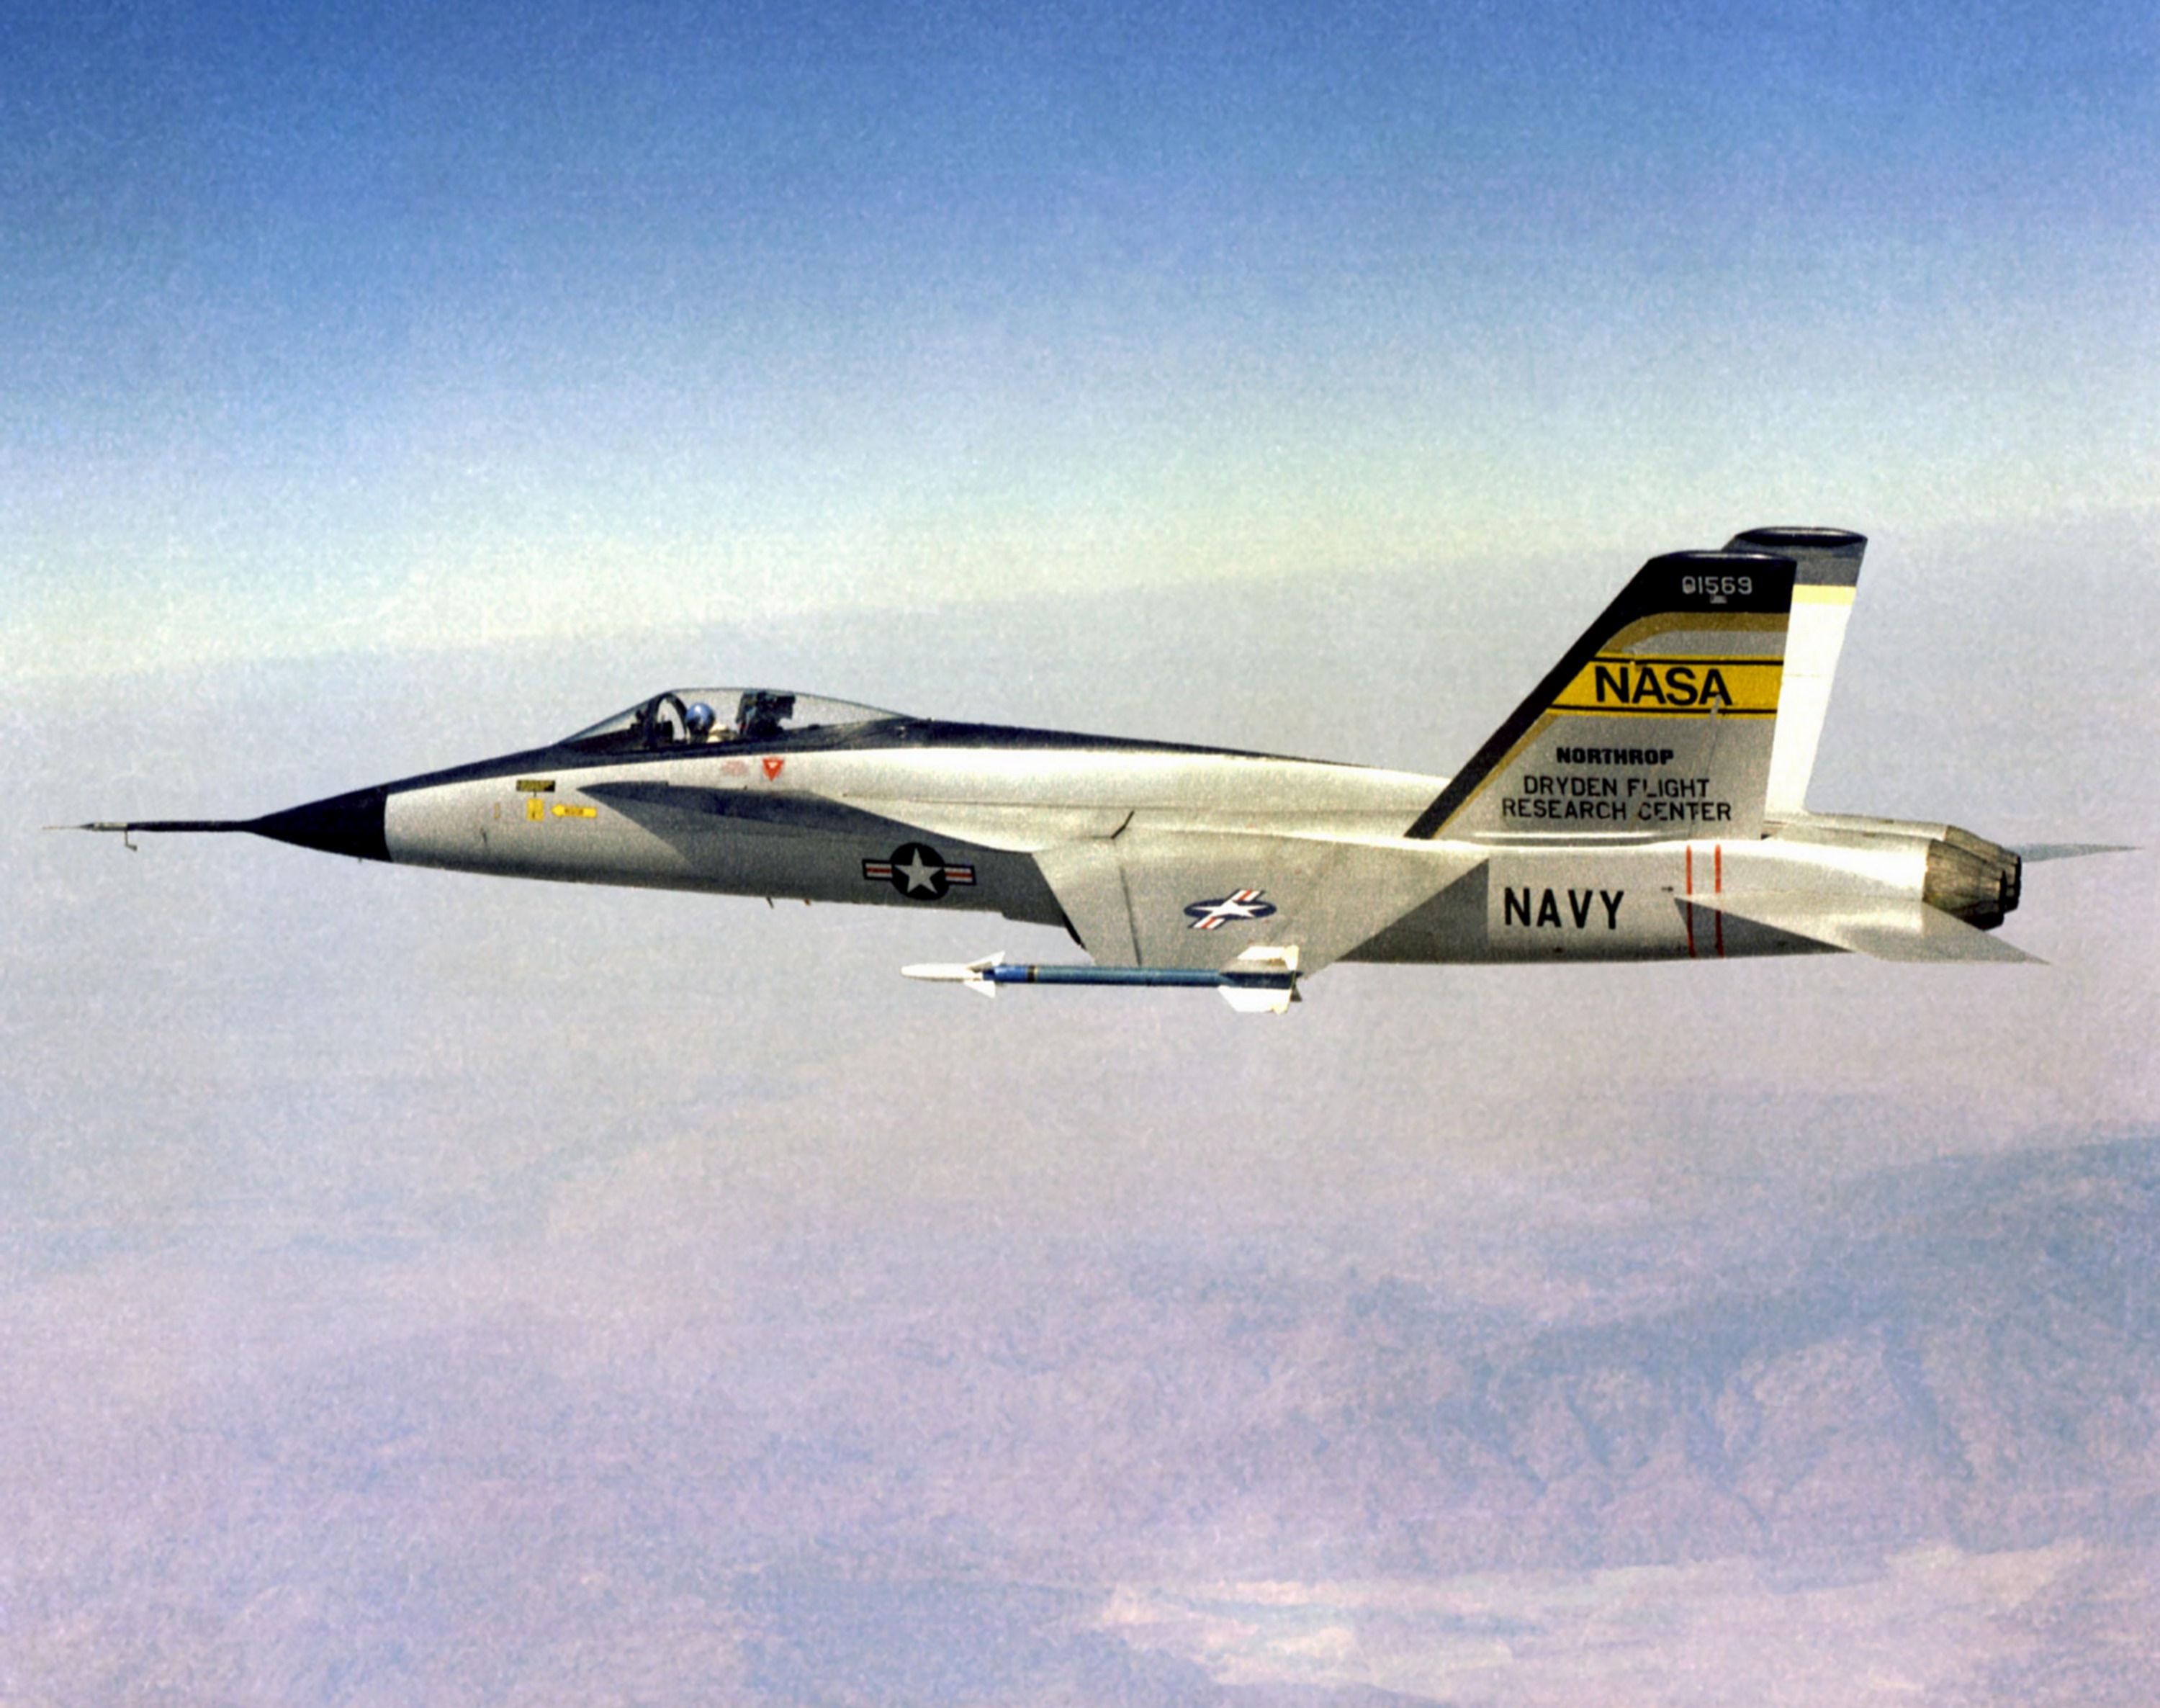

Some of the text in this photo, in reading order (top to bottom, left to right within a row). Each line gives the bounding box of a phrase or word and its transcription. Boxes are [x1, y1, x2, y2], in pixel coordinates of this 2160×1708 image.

[1596, 666, 1732, 706] NASA
[1556, 747, 1675, 765] NORTHROP
[1524, 775, 1710, 798] DRYDEN FLIGHT
[1502, 798, 1732, 822] RESEARCH CENTER
[1504, 886, 1624, 930] NAVY
